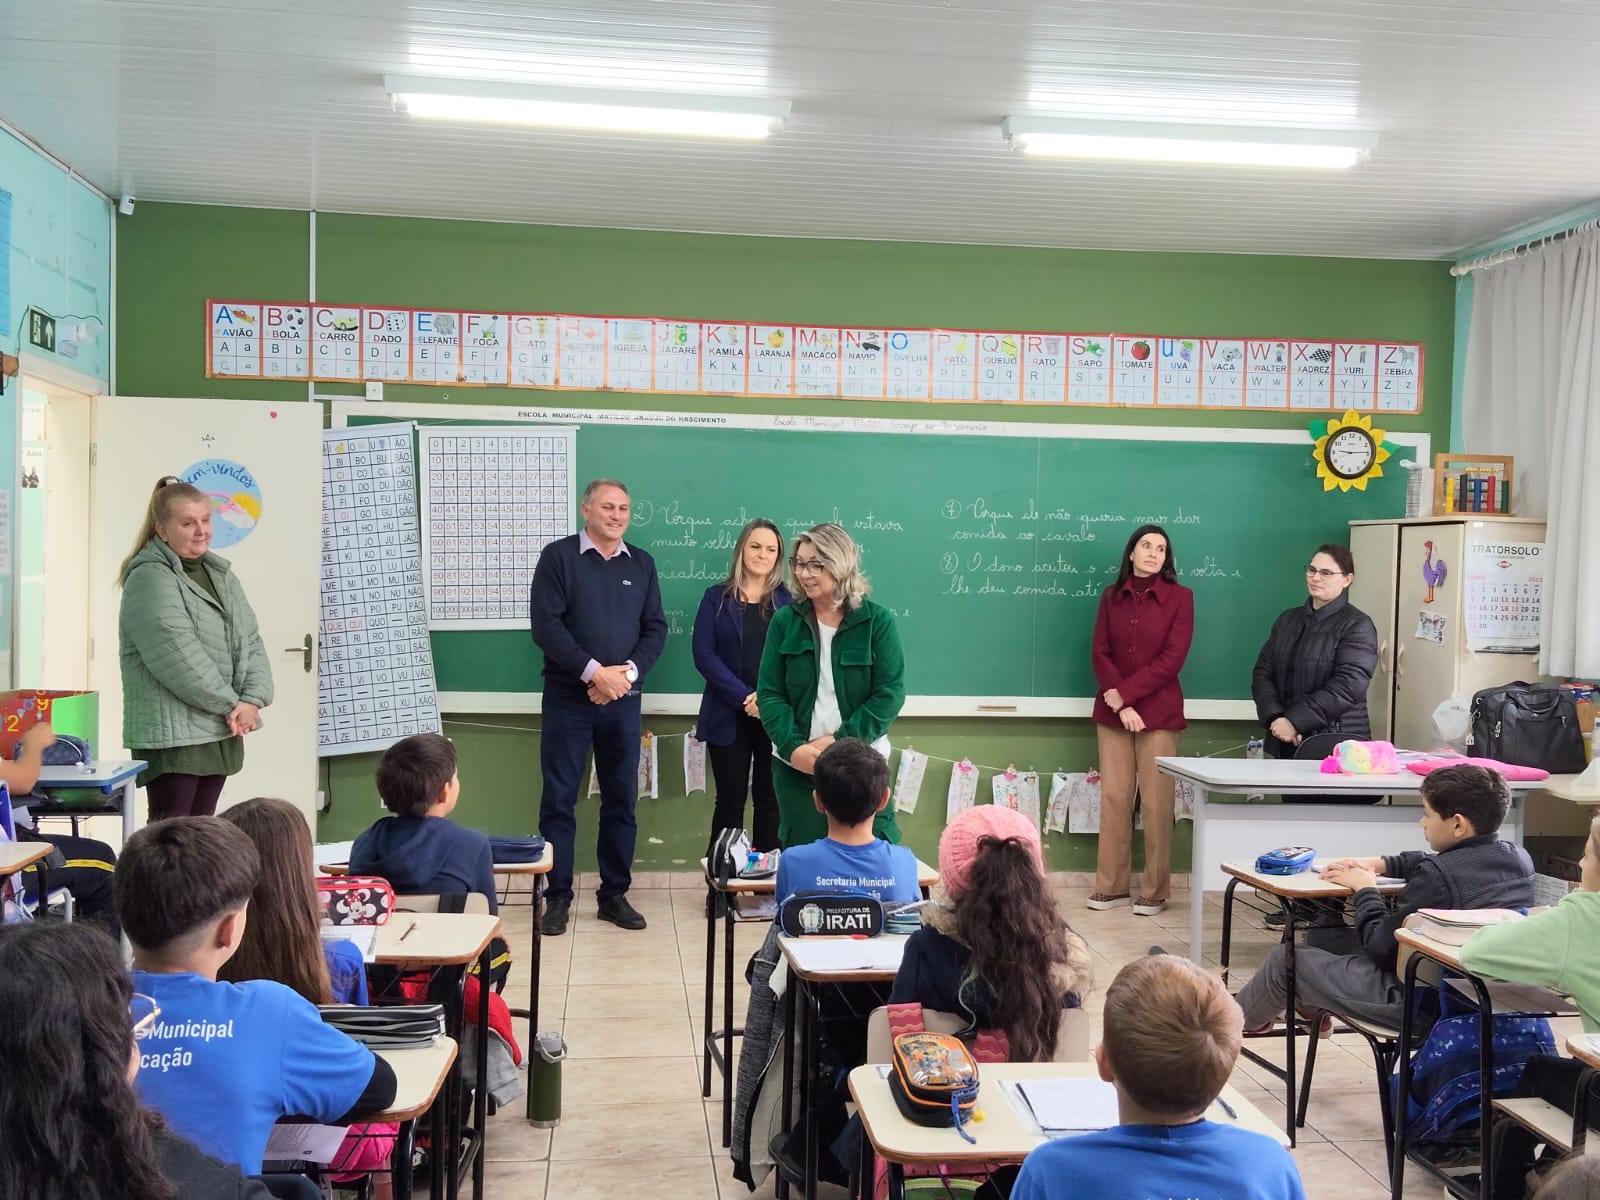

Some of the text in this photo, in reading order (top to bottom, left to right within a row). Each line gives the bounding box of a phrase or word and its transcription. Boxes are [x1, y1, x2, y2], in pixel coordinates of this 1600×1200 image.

[216, 306, 233, 324] A
[268, 308, 282, 326] B
[316, 309, 333, 327] C
[369, 312, 384, 330] D
[418, 314, 432, 332] E
[222, 328, 253, 337] AVIÃO
[468, 316, 480, 333] F
[516, 318, 532, 335] G
[565, 319, 580, 337] H
[659, 324, 669, 341] J
[272, 330, 300, 339] BOLA
[319, 332, 355, 341] CARRO
[373, 335, 402, 344] DADO
[418, 336, 458, 344] ELEFANTE
[473, 338, 499, 346] FOCA
[707, 326, 721, 343] K
[754, 328, 764, 345] L
[800, 330, 816, 347] M
[846, 332, 860, 348] N
[892, 332, 908, 350] O
[938, 334, 950, 351] P
[521, 340, 546, 348] GATO
[614, 343, 648, 352] IGREJA
[982, 335, 998, 352] Q
[1028, 336, 1042, 353] R
[1072, 338, 1086, 355] S
[1117, 339, 1129, 356] T
[1206, 341, 1218, 358] V
[1251, 344, 1270, 359] W
[708, 348, 744, 356] KAMILA
[755, 349, 791, 358] LARANJA
[944, 356, 967, 364] PATO
[1295, 344, 1308, 361] X
[1340, 345, 1353, 362] Y
[1384, 347, 1397, 363] Z
[984, 357, 1017, 365] QUEIJO
[1032, 358, 1056, 366] RATO
[1120, 361, 1153, 369] TOMATE
[1253, 364, 1286, 372] WALTER
[1297, 366, 1330, 374] XADREZ
[1344, 366, 1364, 374] YURI
[1384, 367, 1413, 375] ZEBRA
[679, 416, 726, 424] NASCIMENTO
[433, 439, 439, 447] 0
[460, 439, 467, 447] 2
[475, 439, 481, 447] 3
[488, 439, 494, 447] 4
[503, 439, 508, 447] 5
[516, 439, 522, 447] 6
[530, 439, 535, 447] 7
[544, 439, 549, 447] 8
[557, 439, 563, 447] 9
[182, 462, 255, 488] em-vindos
[853, 508, 904, 531] estava
[1021, 498, 1039, 520] ele
[1045, 508, 1071, 521] não
[1080, 514, 1126, 530] queria
[1172, 506, 1200, 524] dar
[951, 523, 1008, 540] comida
[1016, 531, 1035, 540] ao
[1472, 545, 1540, 556] TRATORSOLO
[984, 555, 1023, 572] dono
[1190, 556, 1226, 577] volta
[942, 574, 1102, 597] lhe deu comida até
[400, 699, 410, 707] XU
[7, 715, 19, 732] 2
[320, 723, 436, 743] ZA ZE ZI ZO ZU ZÃO
[816, 876, 896, 889] Secretaria Municipal
[826, 914, 872, 930] IRATI
[149, 1019, 233, 1042] Municipal
